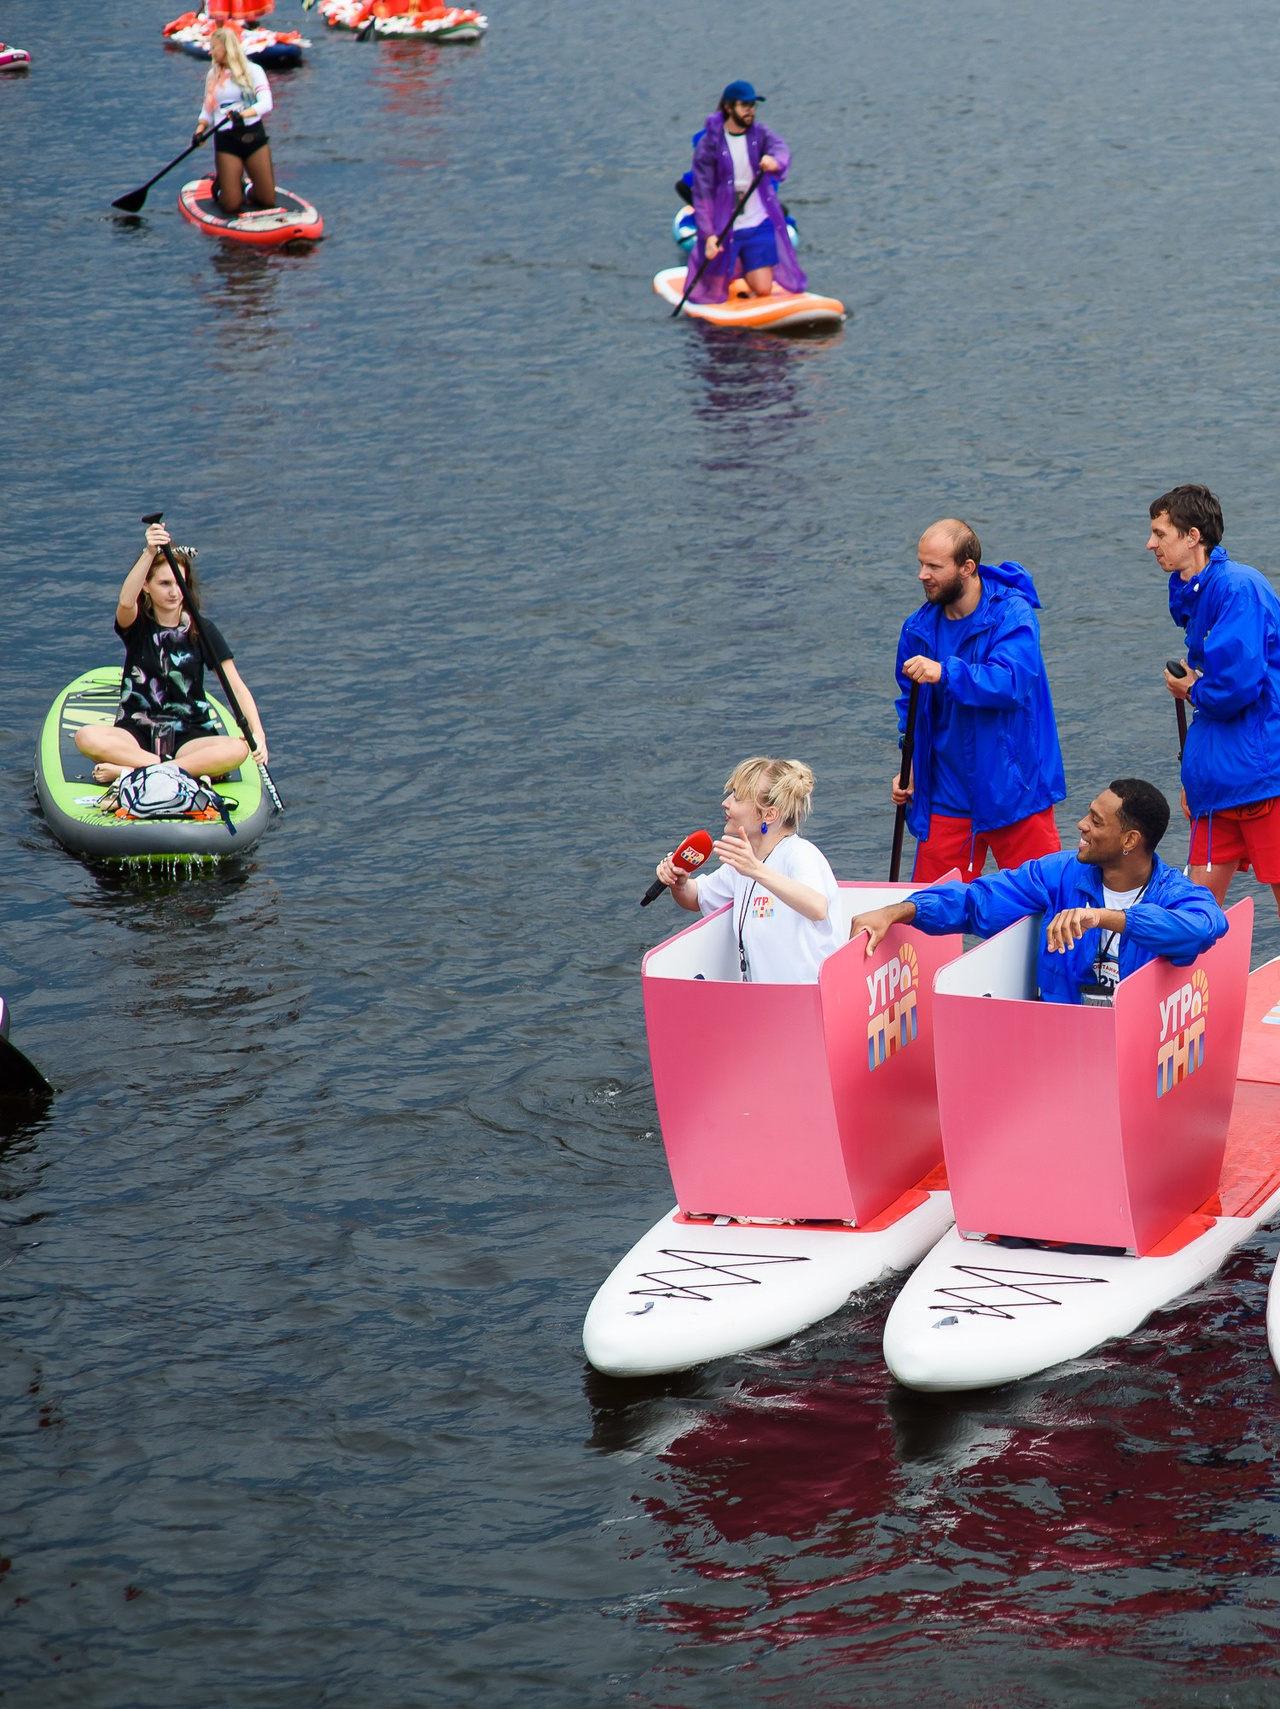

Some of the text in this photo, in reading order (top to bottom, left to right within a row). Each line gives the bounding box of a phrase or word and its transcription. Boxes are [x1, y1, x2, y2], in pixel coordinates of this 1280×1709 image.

[866, 956, 913, 1017] УТРО
[1159, 982, 1202, 1043] УТРО
[868, 989, 918, 1072] ТНТ
[1156, 1016, 1206, 1099] ТНТ
